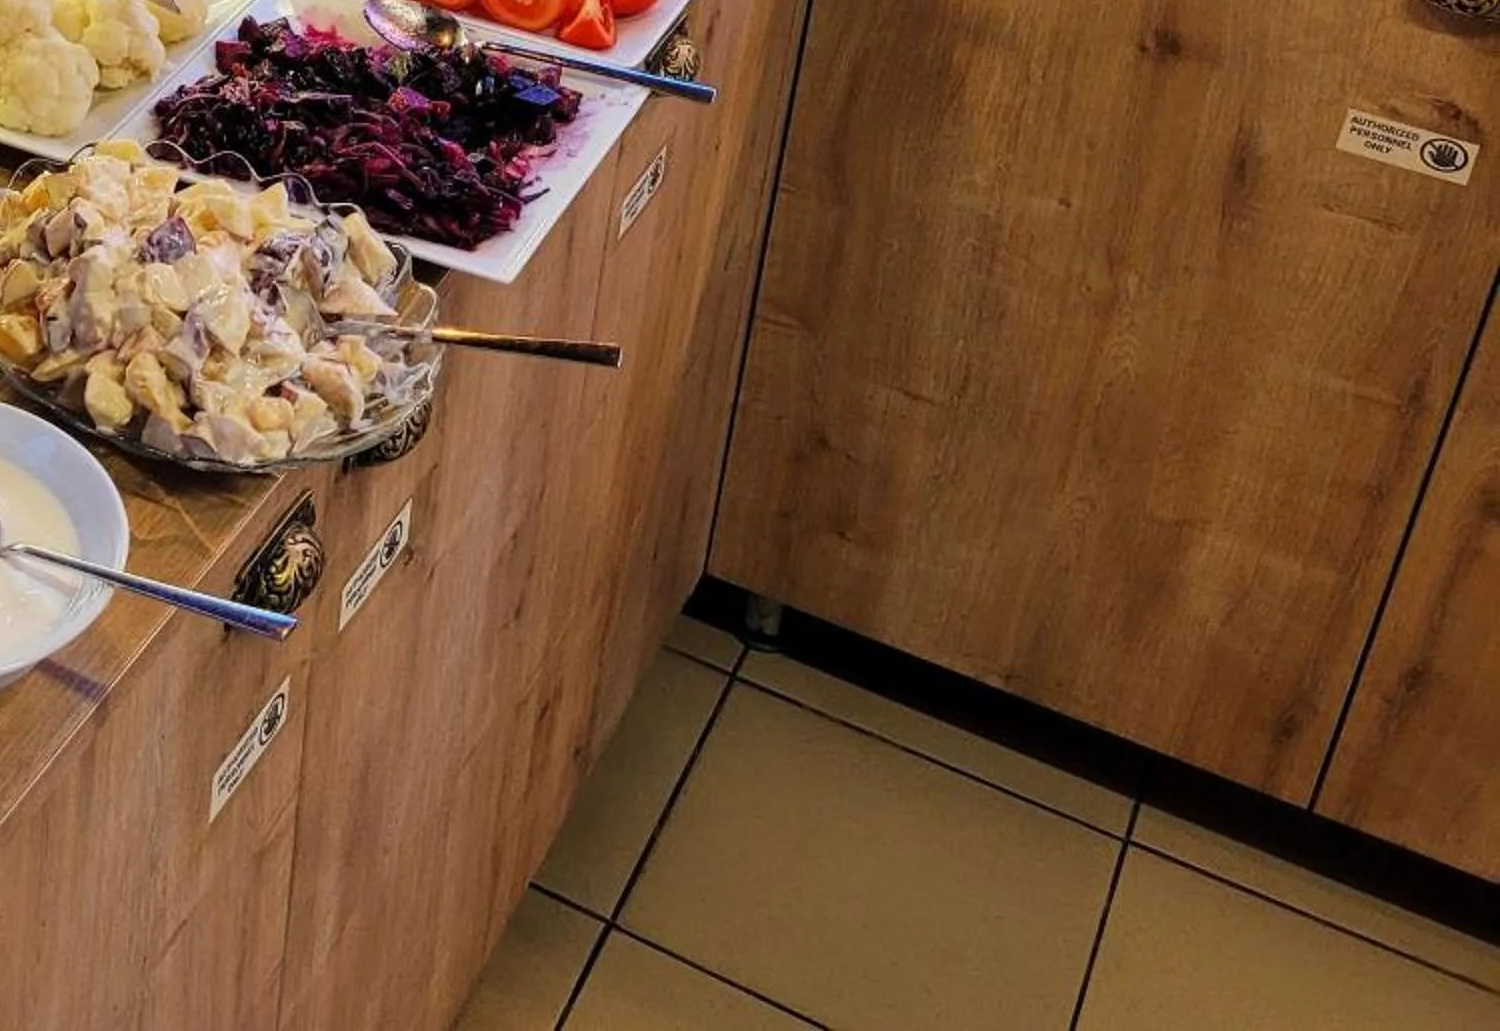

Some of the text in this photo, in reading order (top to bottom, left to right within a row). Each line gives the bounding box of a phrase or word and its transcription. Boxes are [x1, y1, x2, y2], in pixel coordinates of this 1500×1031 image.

[1350, 116, 1420, 142] AUTHORIZED
[1350, 126, 1412, 151] PERSONNEL
[1364, 140, 1393, 154] ONLY
